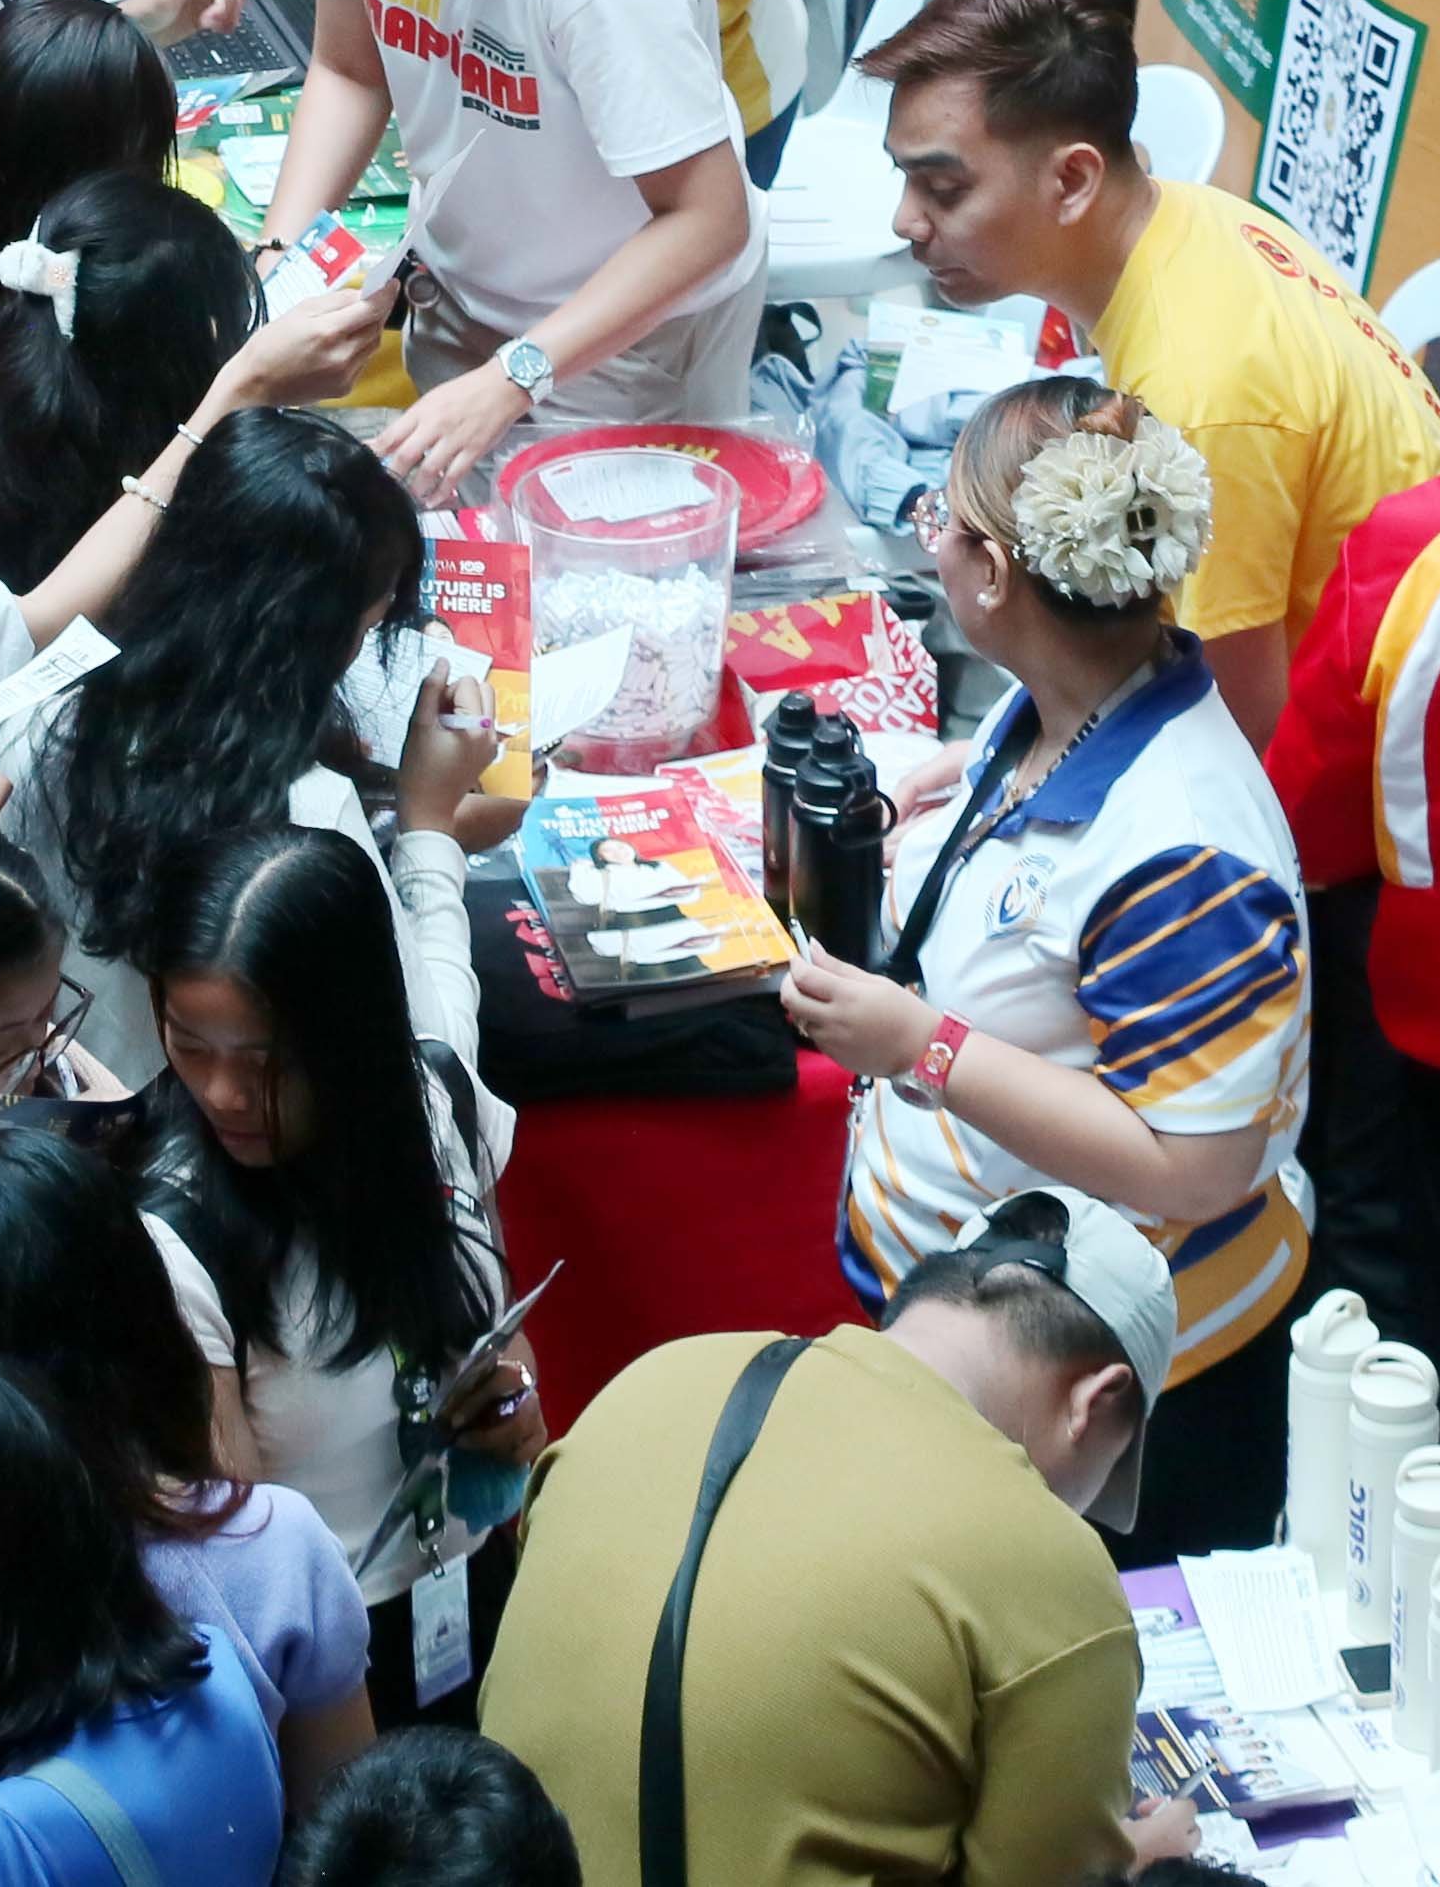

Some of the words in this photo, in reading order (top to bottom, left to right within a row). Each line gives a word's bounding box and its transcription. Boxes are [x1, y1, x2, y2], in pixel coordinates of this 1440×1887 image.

[419, 579, 484, 599] UTURE
[487, 583, 506, 599] IS
[442, 596, 493, 614] HERE
